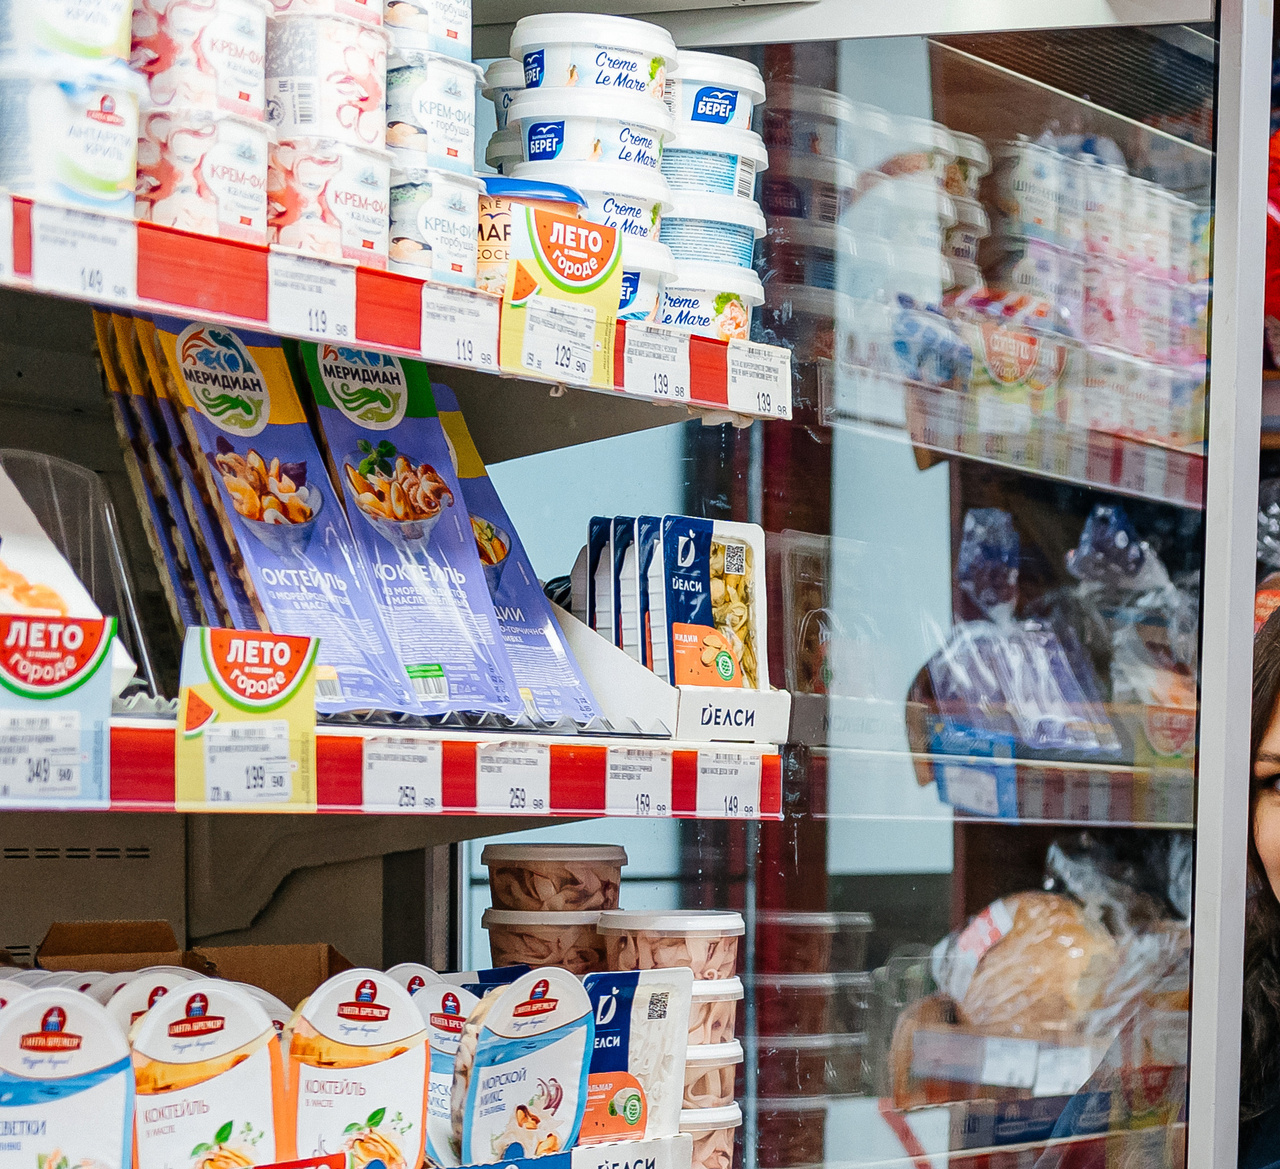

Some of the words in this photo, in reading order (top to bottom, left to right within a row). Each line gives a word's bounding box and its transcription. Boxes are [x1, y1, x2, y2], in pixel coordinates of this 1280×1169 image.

[596, 52, 637, 71] Crème
[596, 70, 611, 85] Le
[613, 72, 645, 92] Mare
[698, 102, 732, 117] БЕРЕГ
[531, 138, 558, 153] БЕРЕГ
[620, 128, 652, 149] Crème
[619, 146, 631, 161] Le
[634, 153, 657, 168] Mare
[604, 198, 642, 218] Crème
[550, 222, 602, 252] ЛЕТО
[618, 219, 648, 237] Mare
[553, 249, 598, 278] городе
[308, 309, 327, 332] 119
[675, 311, 711, 327] Mare
[457, 339, 473, 361] 119
[481, 353, 491, 364] 98
[555, 344, 571, 368] 129
[184, 368, 262, 393] МЕРИДИАН
[323, 363, 401, 387] МЕРИДИАН
[654, 373, 668, 394] 139
[674, 386, 684, 397] 98
[757, 392, 771, 413] 139
[778, 406, 787, 415] 98
[258, 566, 347, 591] ОКТЕЙЛЬ
[6, 622, 84, 649] ЛЕТО
[227, 639, 291, 665] ЛЕТО
[9, 653, 77, 682] городе
[231, 672, 285, 694] городе
[636, 794, 649, 815] 159
[724, 795, 738, 816] 149
[594, 1036, 620, 1048] ЕЛСИ
[305, 1079, 367, 1096] КОКТЕЙЛЬ
[482, 1068, 526, 1089] МОРСКОЙ
[481, 1090, 503, 1106] МИКС
